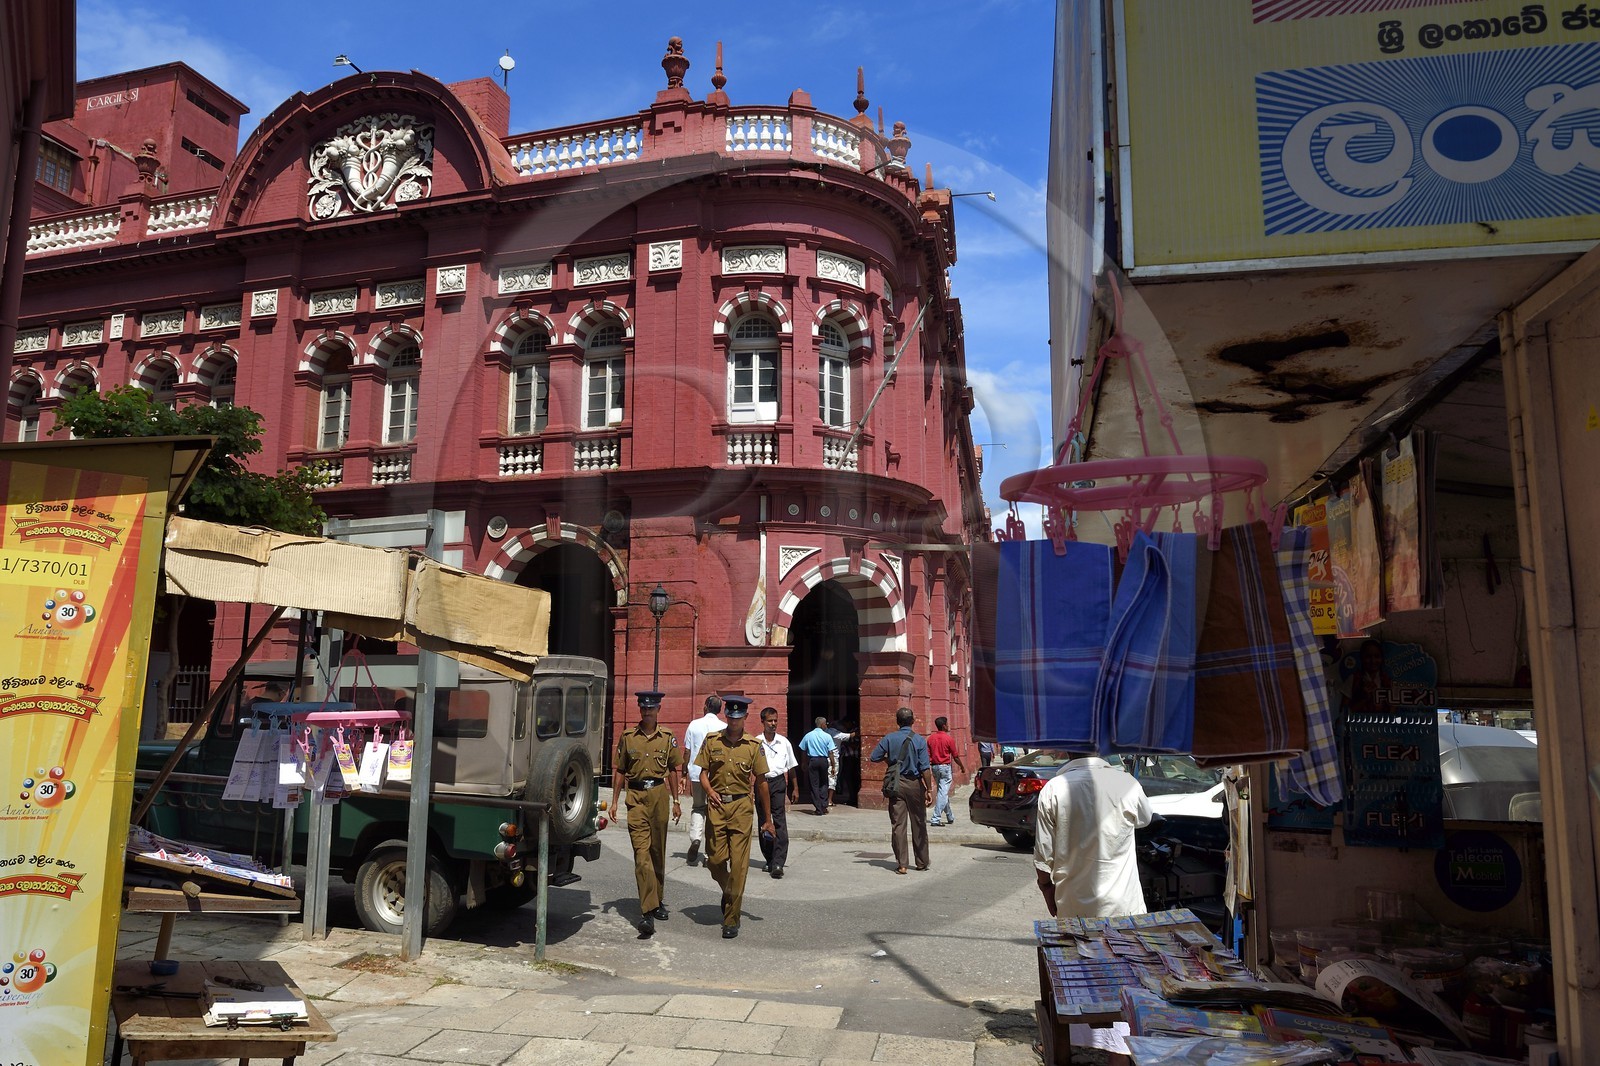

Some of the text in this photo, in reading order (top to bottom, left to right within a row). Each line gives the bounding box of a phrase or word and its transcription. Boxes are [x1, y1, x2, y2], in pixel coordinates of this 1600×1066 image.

[1418, 4, 1548, 50] ලංකාවේ
[1, 557, 88, 577] 1/7370/01
[1448, 849, 1504, 863] Telecom
[1455, 866, 1502, 881] Mobitel
